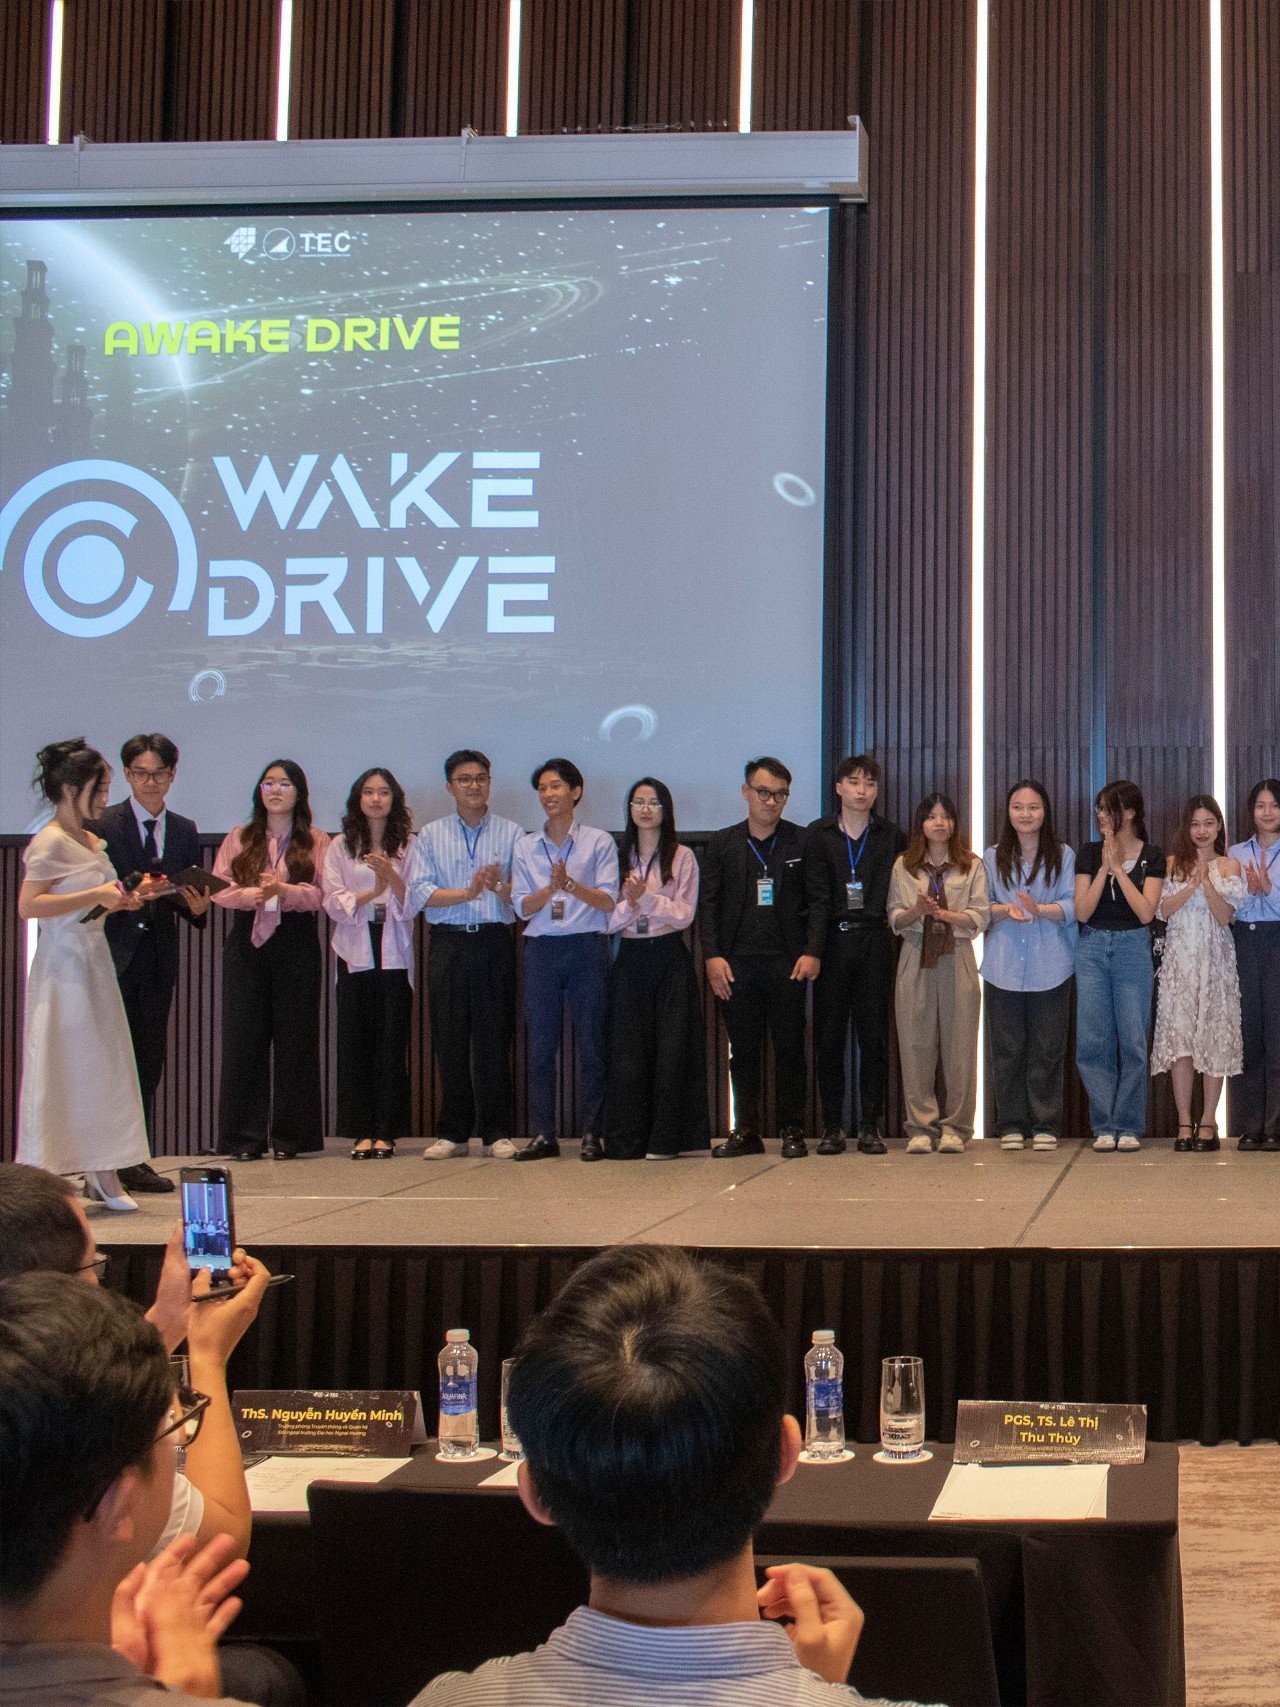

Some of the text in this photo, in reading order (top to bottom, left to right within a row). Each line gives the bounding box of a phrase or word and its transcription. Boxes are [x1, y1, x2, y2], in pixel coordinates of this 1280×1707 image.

[300, 232, 351, 253] TEC
[104, 316, 461, 356] AWAKE DRIVE
[212, 452, 541, 531] WAKE
[208, 556, 556, 637] DRIVE
[241, 1408, 268, 1419] ThS.
[272, 1407, 322, 1422] Nguyễn
[370, 1410, 402, 1421] Minh
[1004, 1414, 1098, 1430] PGS, TS. Lê Thị
[1020, 1432, 1081, 1446] Thu Thủy
